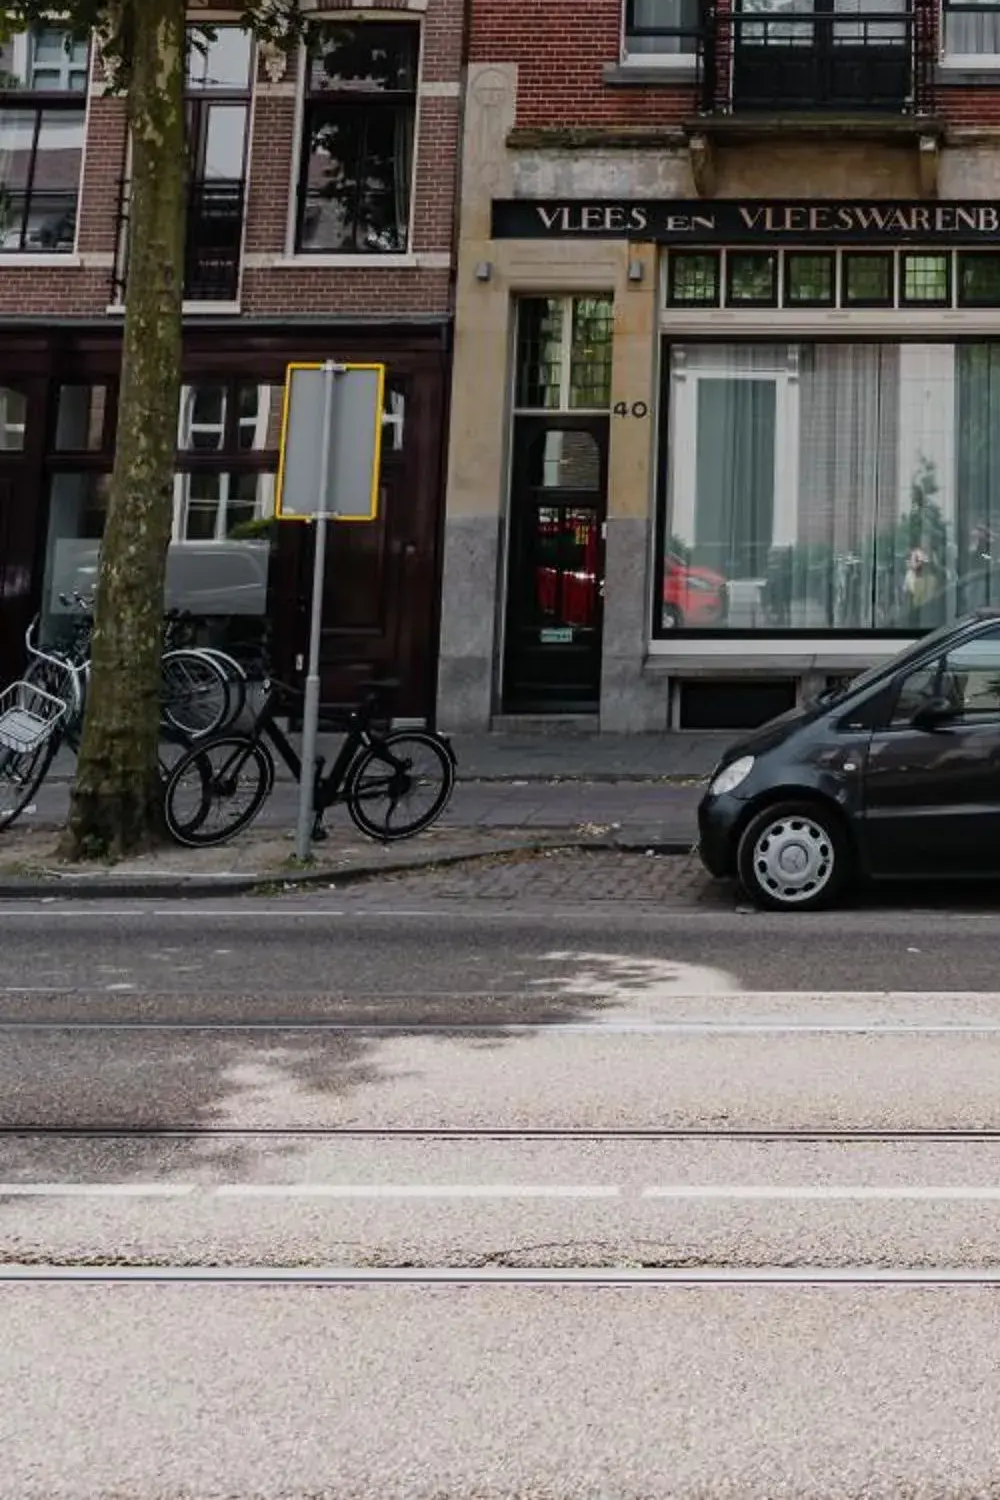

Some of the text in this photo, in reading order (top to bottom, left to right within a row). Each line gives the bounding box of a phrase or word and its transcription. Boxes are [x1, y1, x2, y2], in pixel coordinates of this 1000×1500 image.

[535, 206, 647, 231] VLEES
[665, 215, 715, 231] EN
[613, 401, 647, 418] 40
